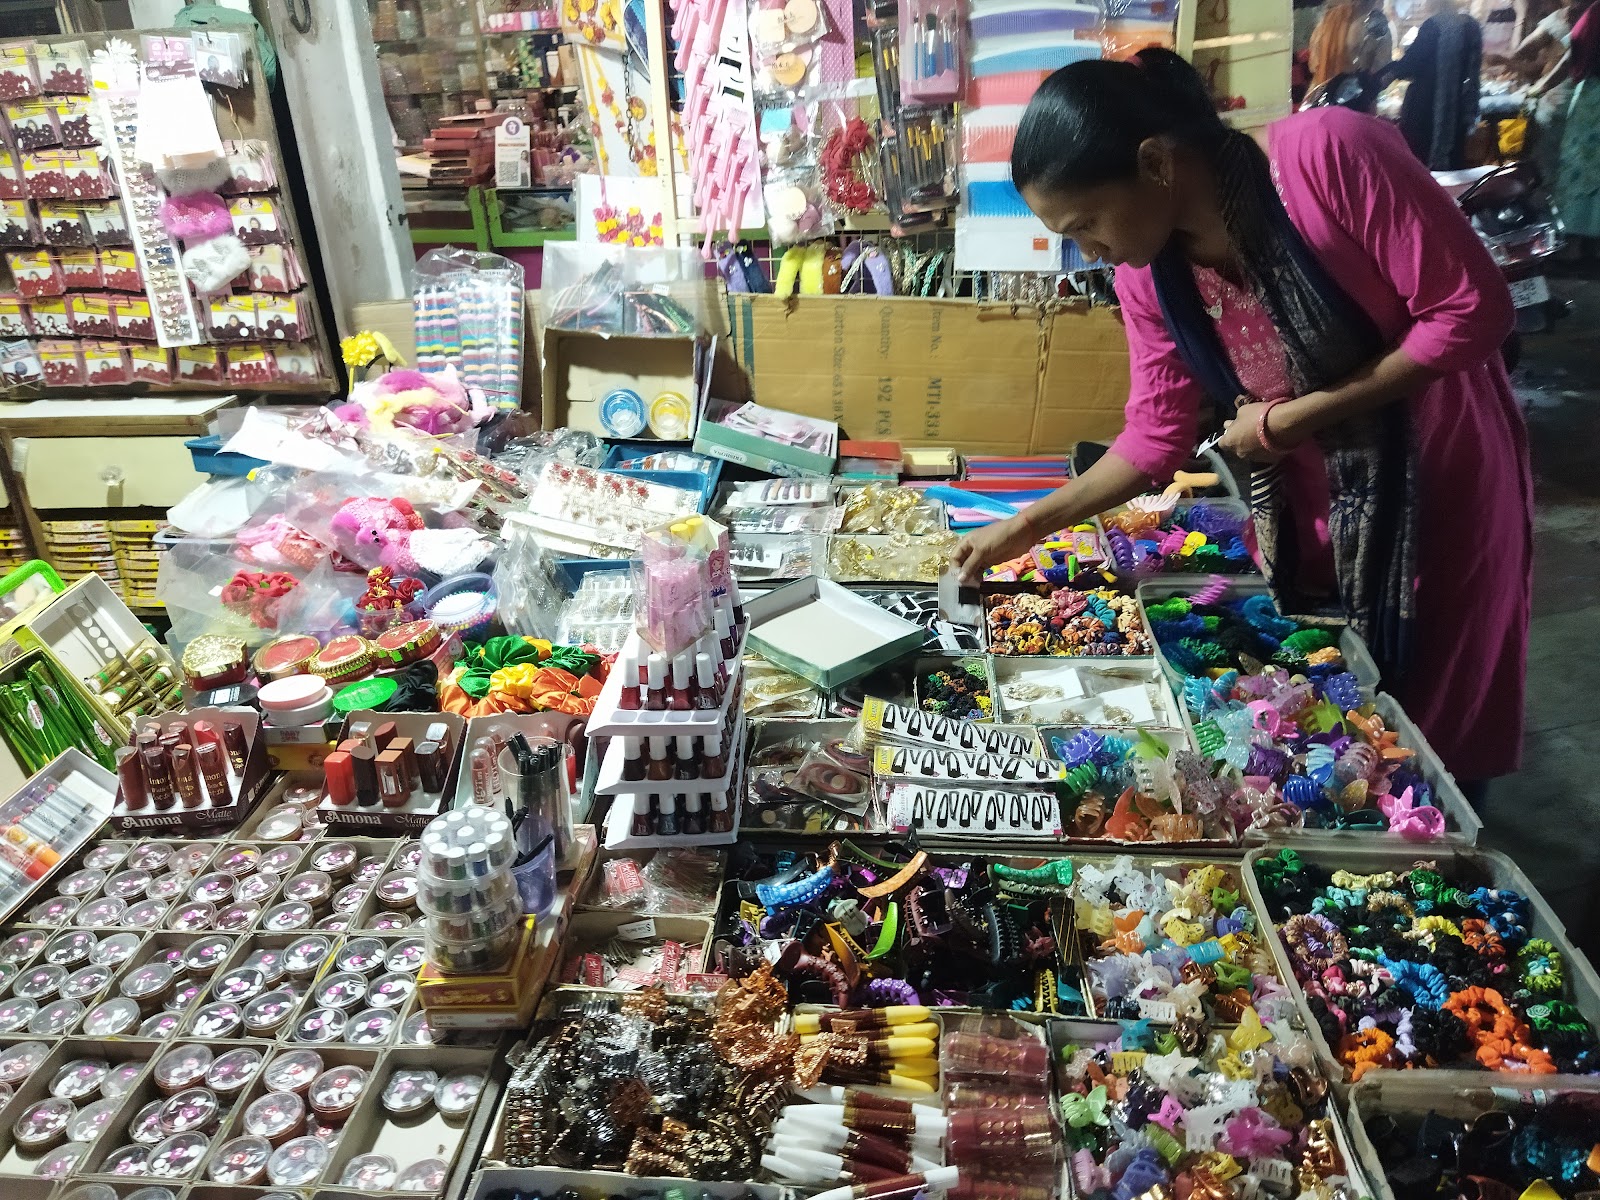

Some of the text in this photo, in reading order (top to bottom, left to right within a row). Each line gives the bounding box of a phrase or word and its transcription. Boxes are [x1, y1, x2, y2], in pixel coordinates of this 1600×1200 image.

[833, 305, 846, 347] Carton
[877, 377, 893, 402] 192
[876, 410, 892, 436] PCS
[121, 808, 233, 829] Amona Matte
[324, 811, 382, 824] Amona
